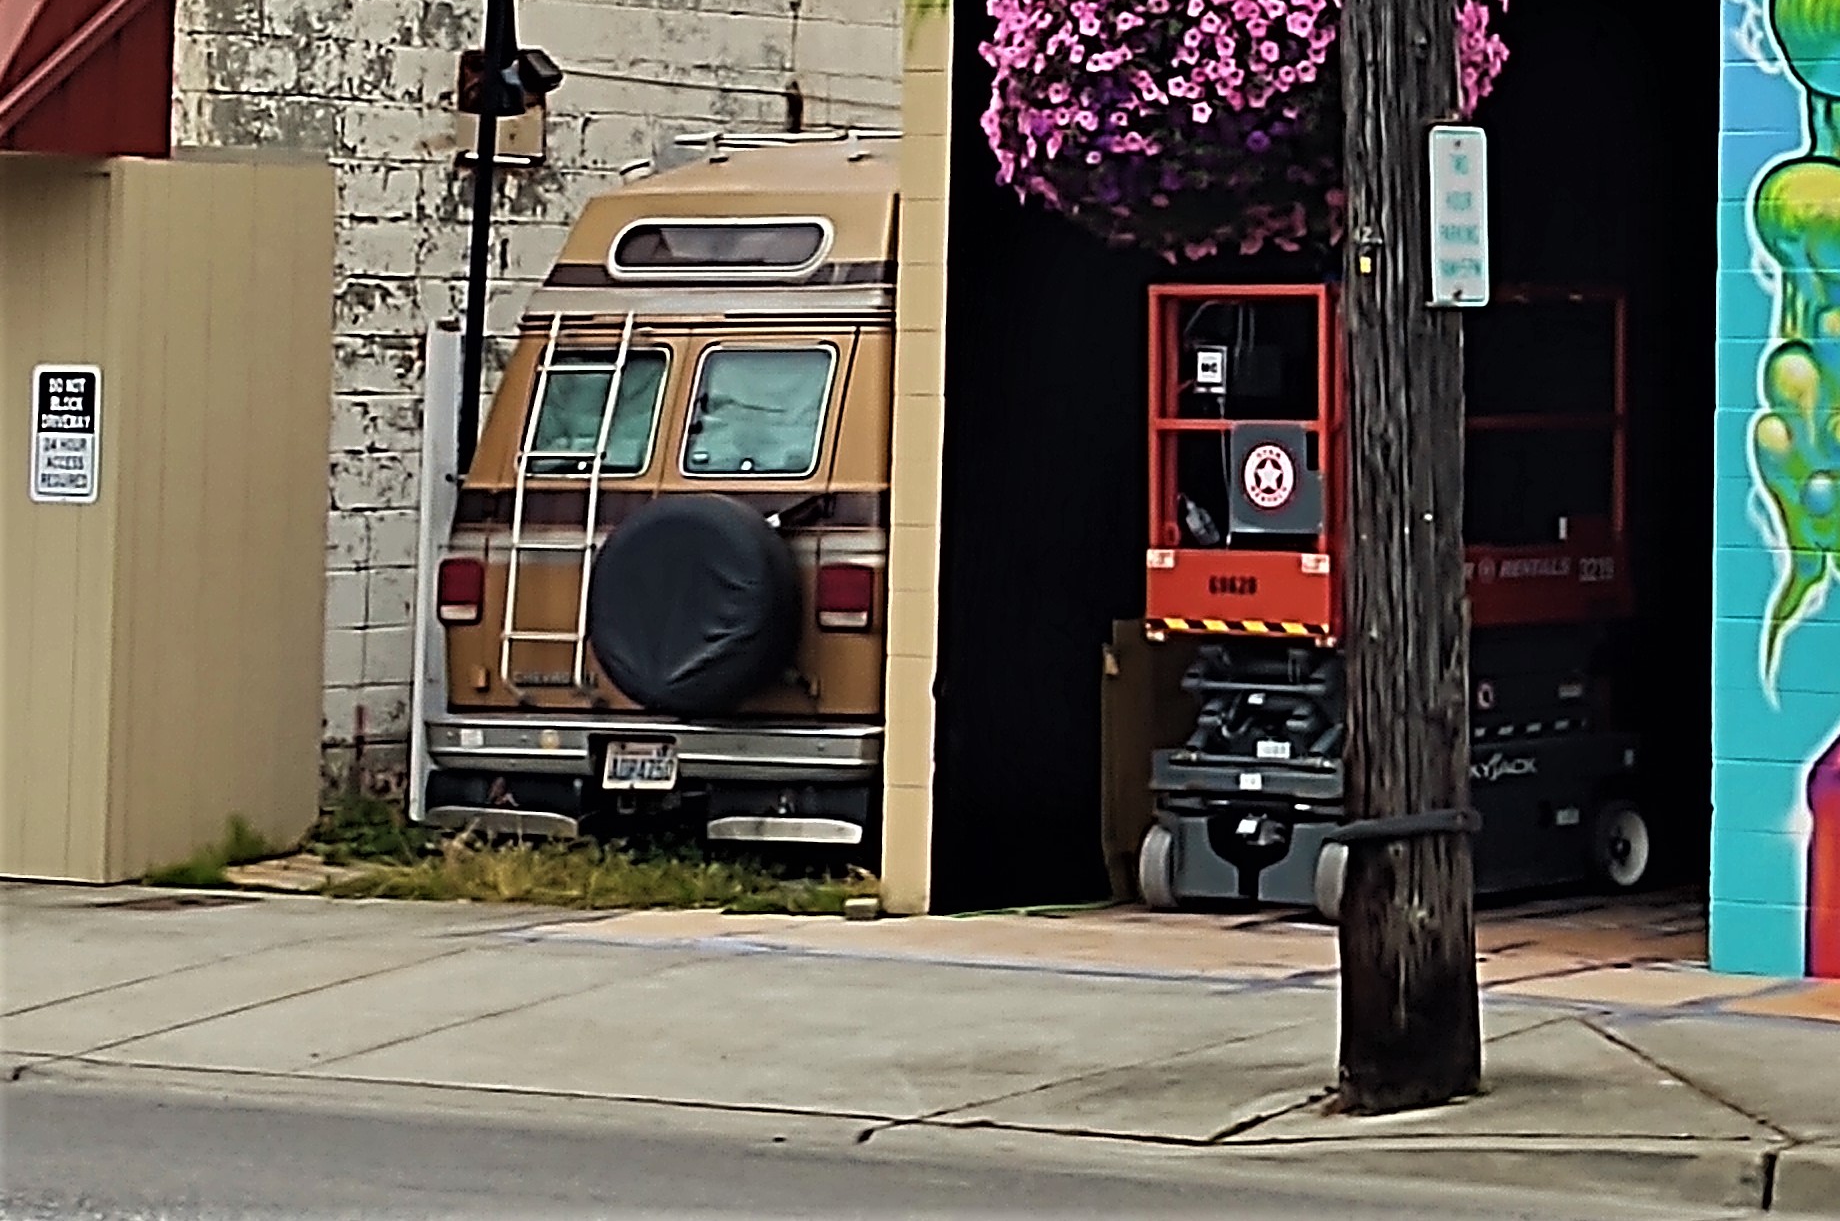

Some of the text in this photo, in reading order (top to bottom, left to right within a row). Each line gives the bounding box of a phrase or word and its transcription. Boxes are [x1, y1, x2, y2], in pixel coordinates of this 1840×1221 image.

[49, 378, 86, 393] DO NOT
[50, 396, 83, 411] BLOCK
[41, 413, 91, 429] DRIVEWAY
[60, 438, 87, 452] HOUR
[47, 456, 84, 470] ACCESS
